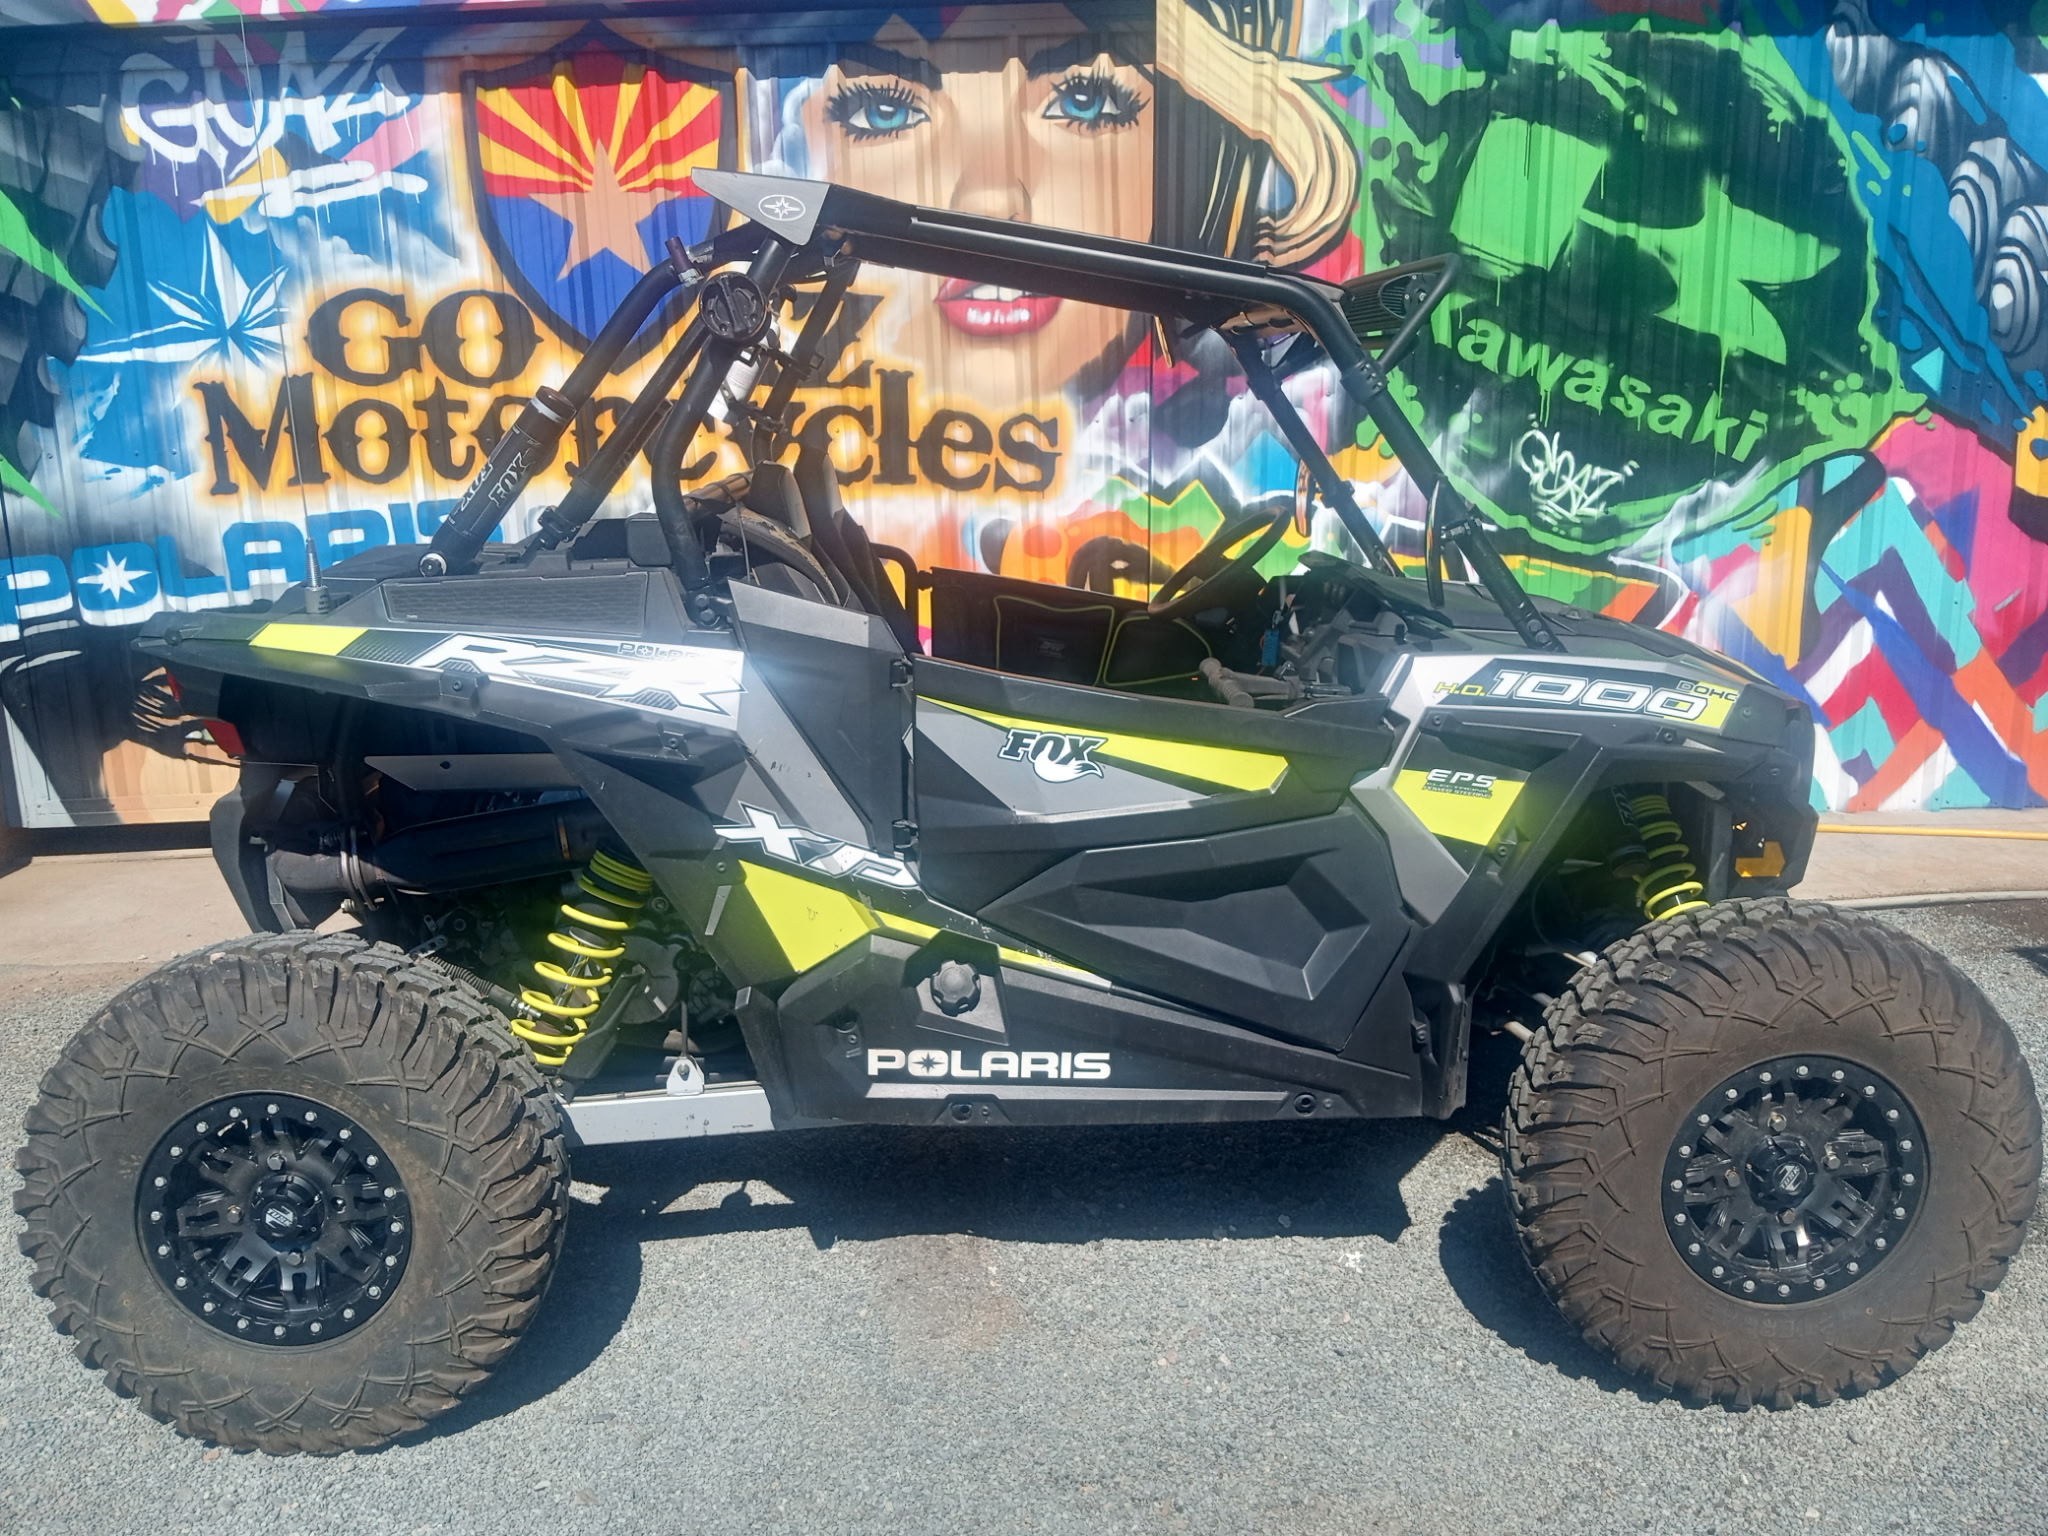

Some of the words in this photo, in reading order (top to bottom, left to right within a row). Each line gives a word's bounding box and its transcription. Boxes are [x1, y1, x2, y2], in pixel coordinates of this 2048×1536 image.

[304, 288, 546, 387] GO
[192, 366, 1063, 498] Motorcles
[488, 450, 530, 508] FOX
[1486, 669, 1708, 721] 1000
[1676, 680, 1739, 702] DOHC
[999, 729, 1106, 768] FOX
[1427, 768, 1498, 788] EPS
[867, 1048, 1112, 1080] POLARIS
